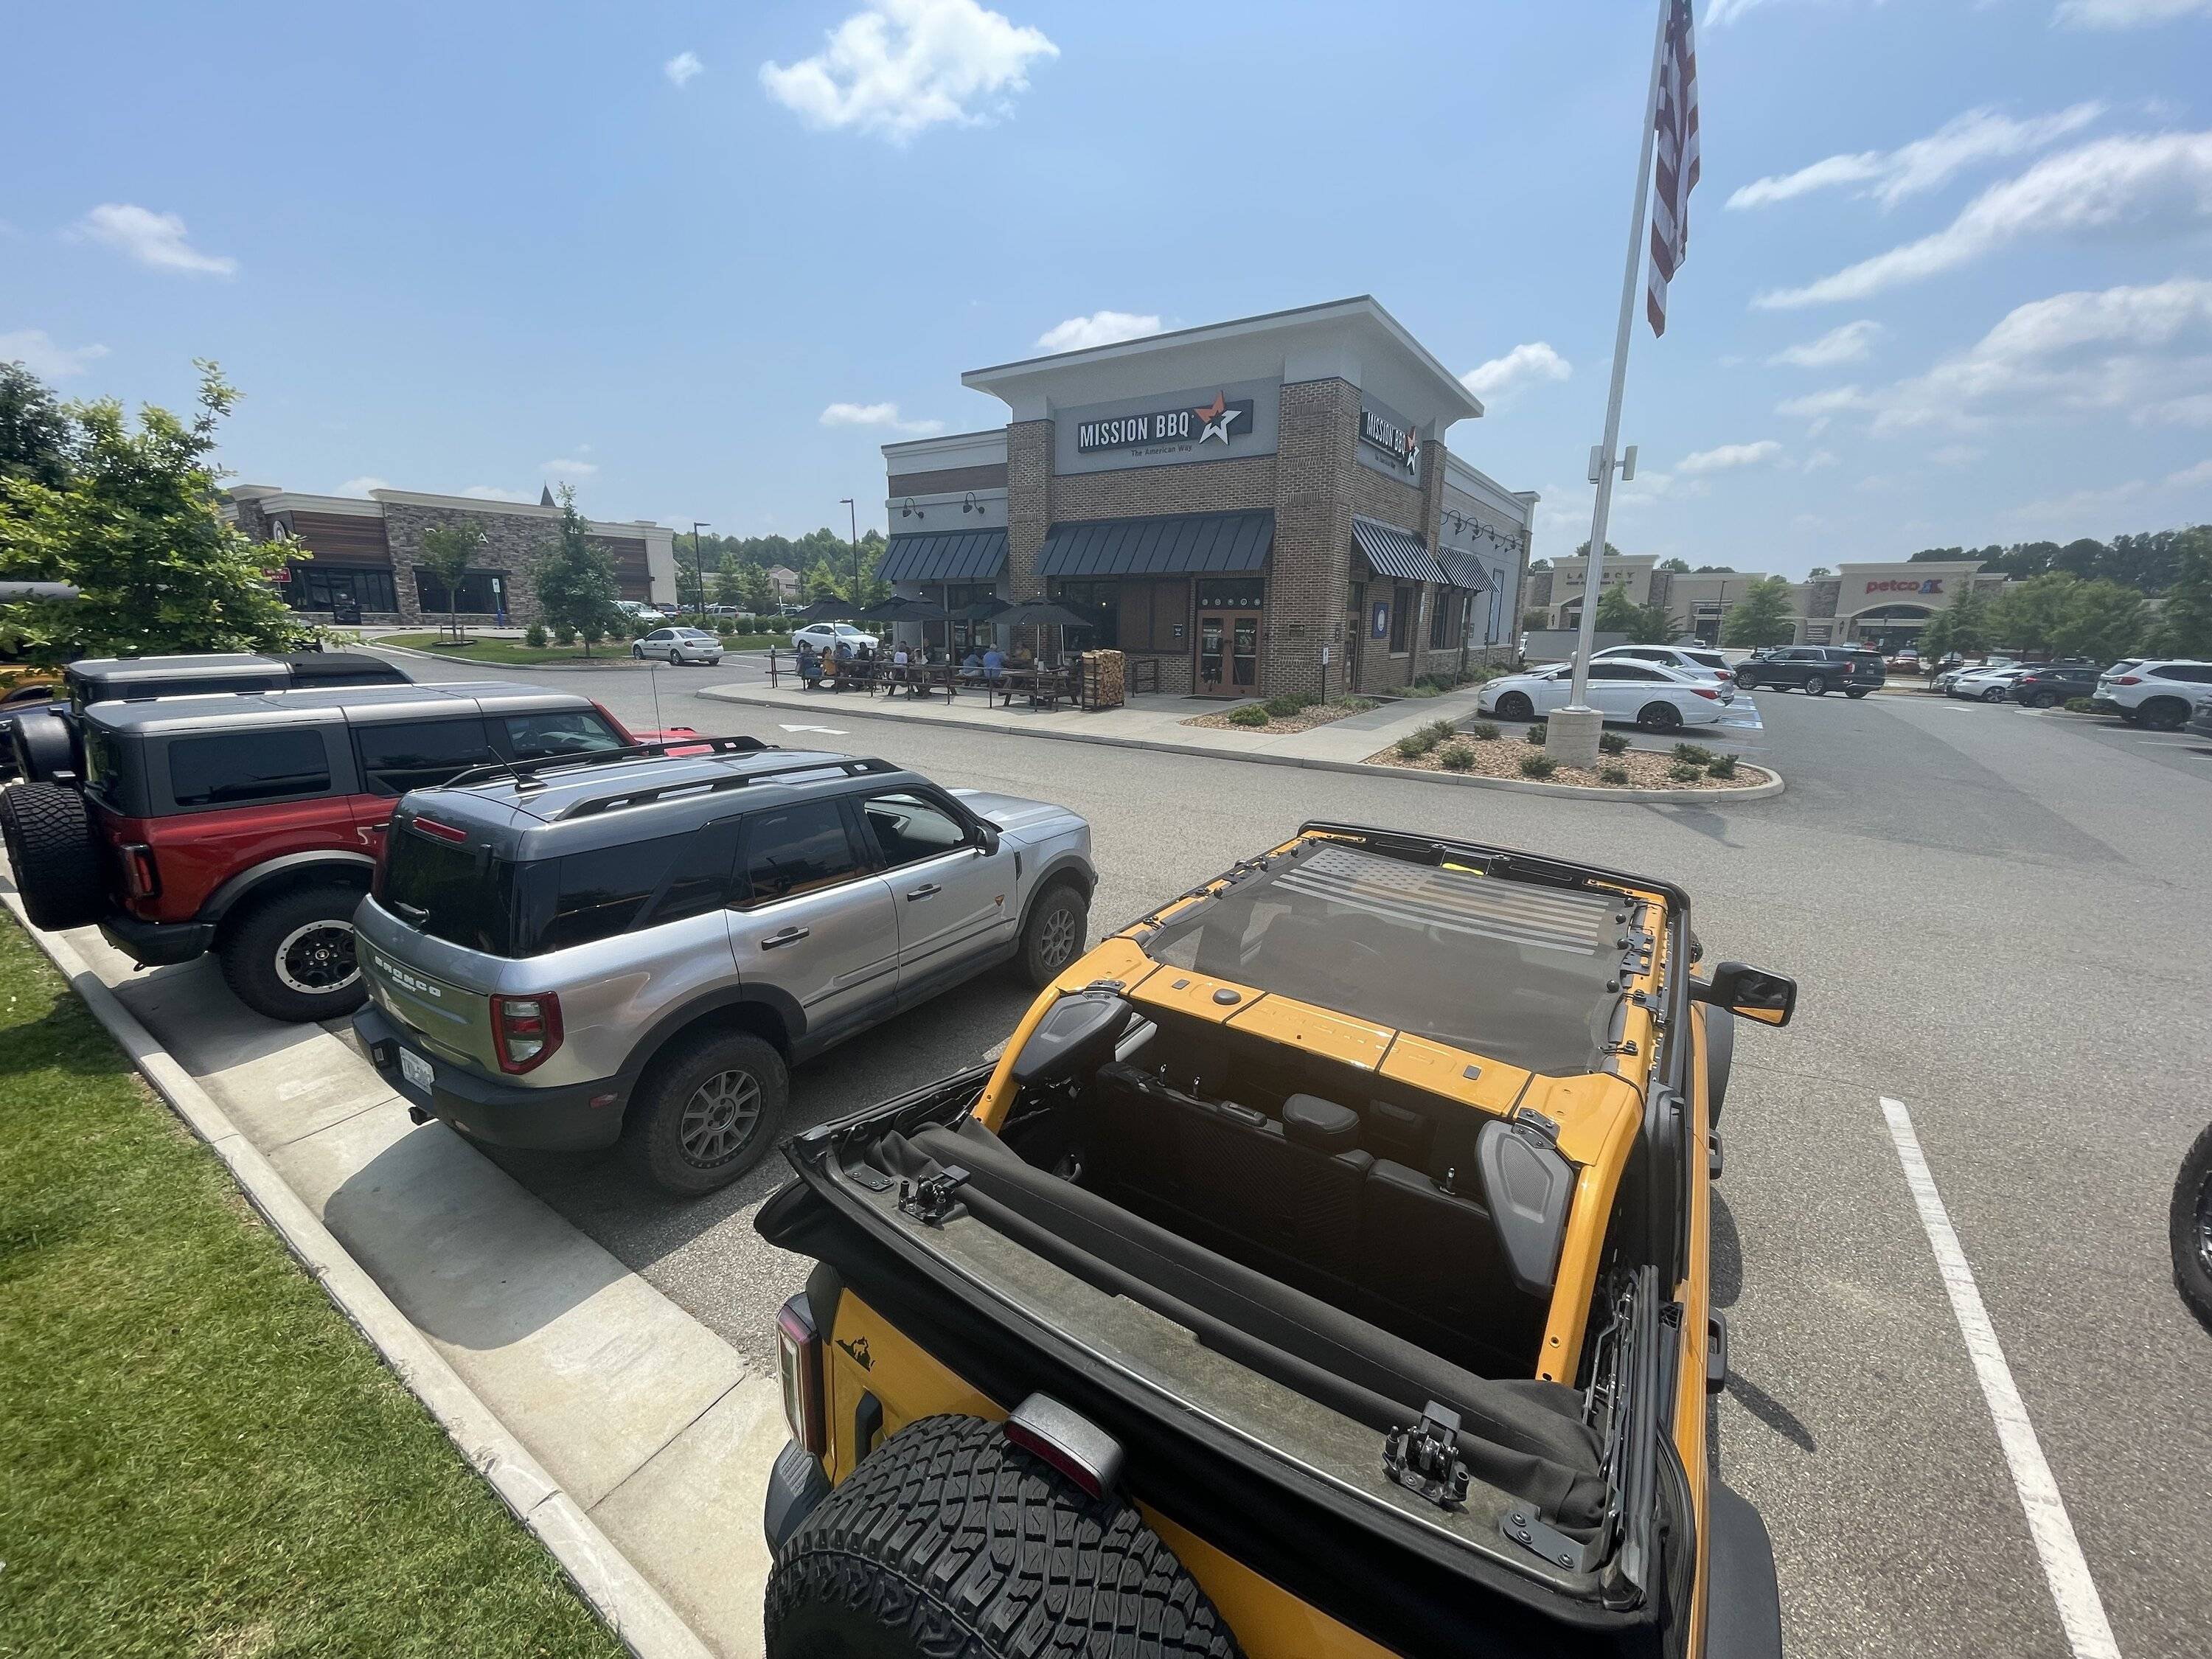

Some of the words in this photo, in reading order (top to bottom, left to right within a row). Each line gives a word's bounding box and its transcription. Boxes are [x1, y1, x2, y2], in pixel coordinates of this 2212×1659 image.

[1079, 417, 1148, 448] MISSION
[1155, 411, 1189, 439] BBQ
[1366, 411, 1394, 448] MISSION
[1131, 448, 1142, 457] The
[1144, 446, 1176, 456] American
[1178, 444, 1192, 453] Way
[1865, 579, 1920, 594] petco
[375, 956, 442, 998] BRONCO
